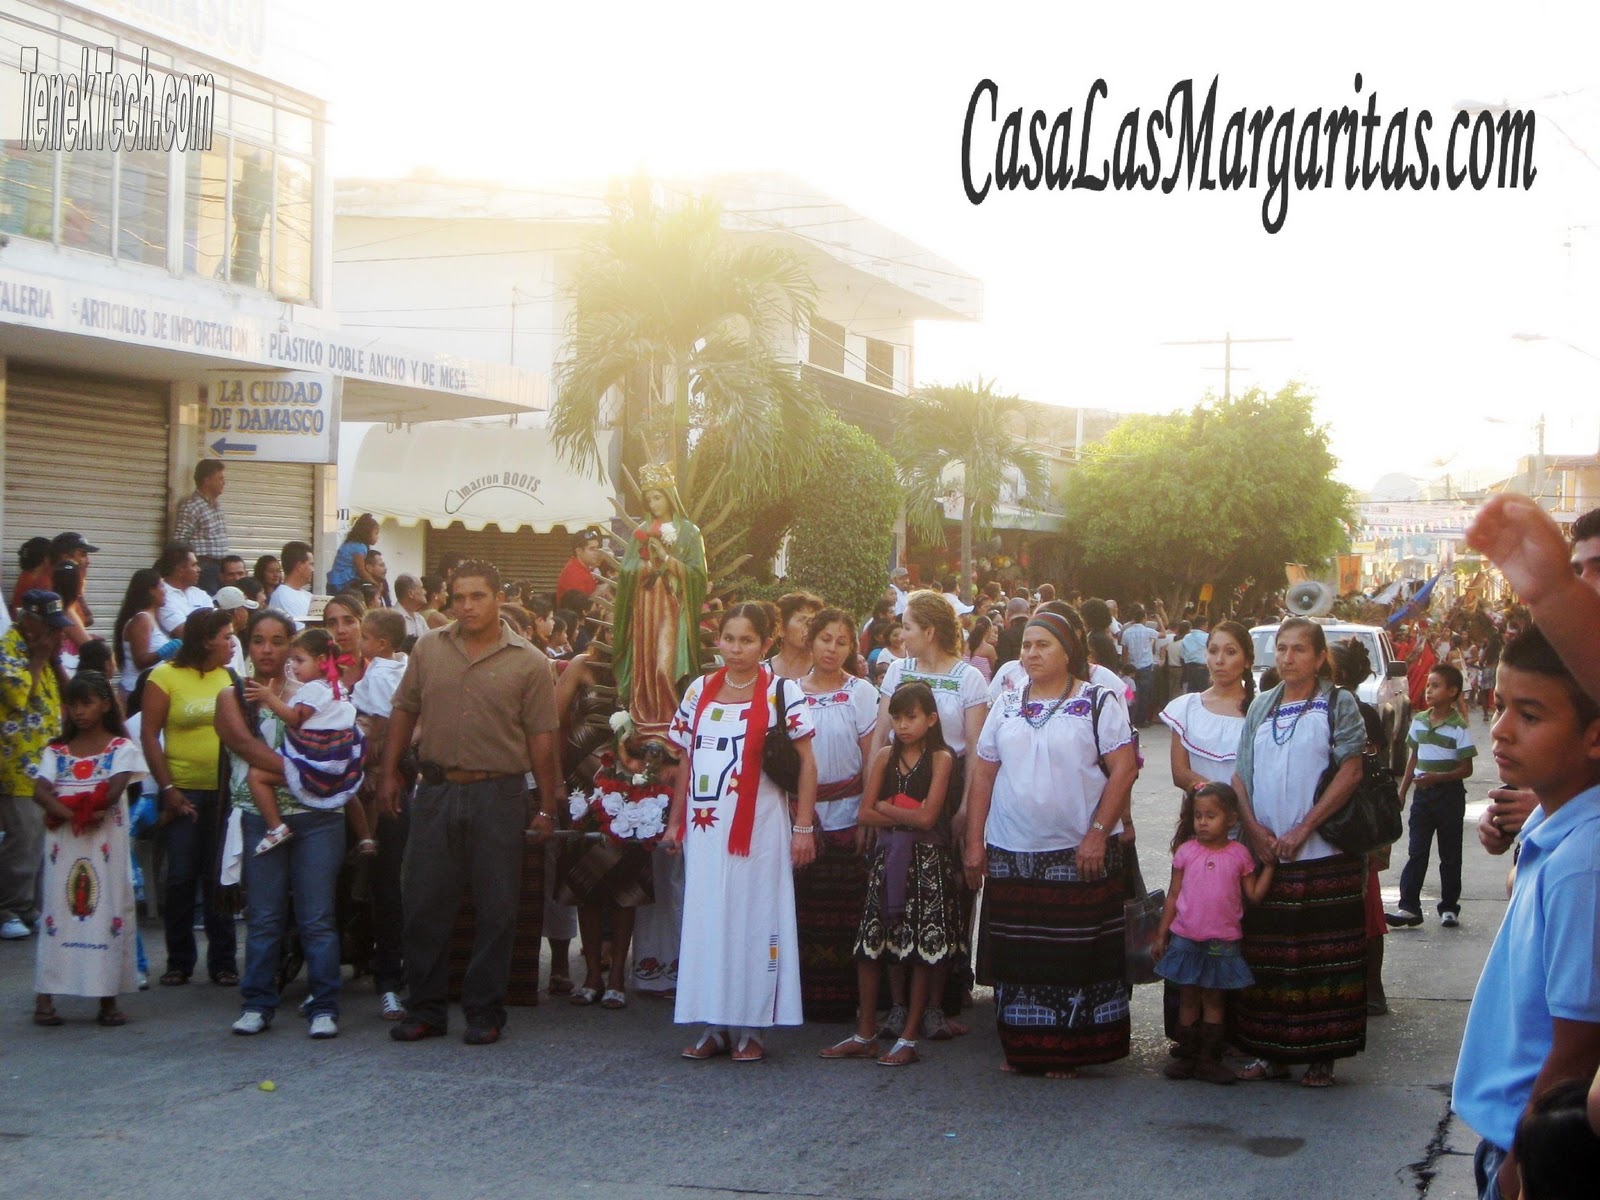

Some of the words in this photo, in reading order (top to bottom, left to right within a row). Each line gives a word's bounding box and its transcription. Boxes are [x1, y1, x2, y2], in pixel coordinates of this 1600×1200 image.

[0, 280, 54, 319] ALERIA
[80, 297, 146, 336] ARTICULOS
[152, 311, 168, 340] DE
[170, 314, 249, 354] IMPORTACION
[269, 333, 324, 366] PLASTICO
[328, 343, 364, 374] DOBLE
[368, 351, 406, 381] ANCHO
[410, 360, 420, 383] Y
[421, 361, 435, 386] DE
[440, 365, 467, 390] MESA
[218, 379, 245, 404] LA
[248, 380, 323, 405] CIUDAD
[208, 407, 233, 432] DE
[236, 408, 325, 435] DAMASCO
[502, 471, 542, 493] BOOTS
